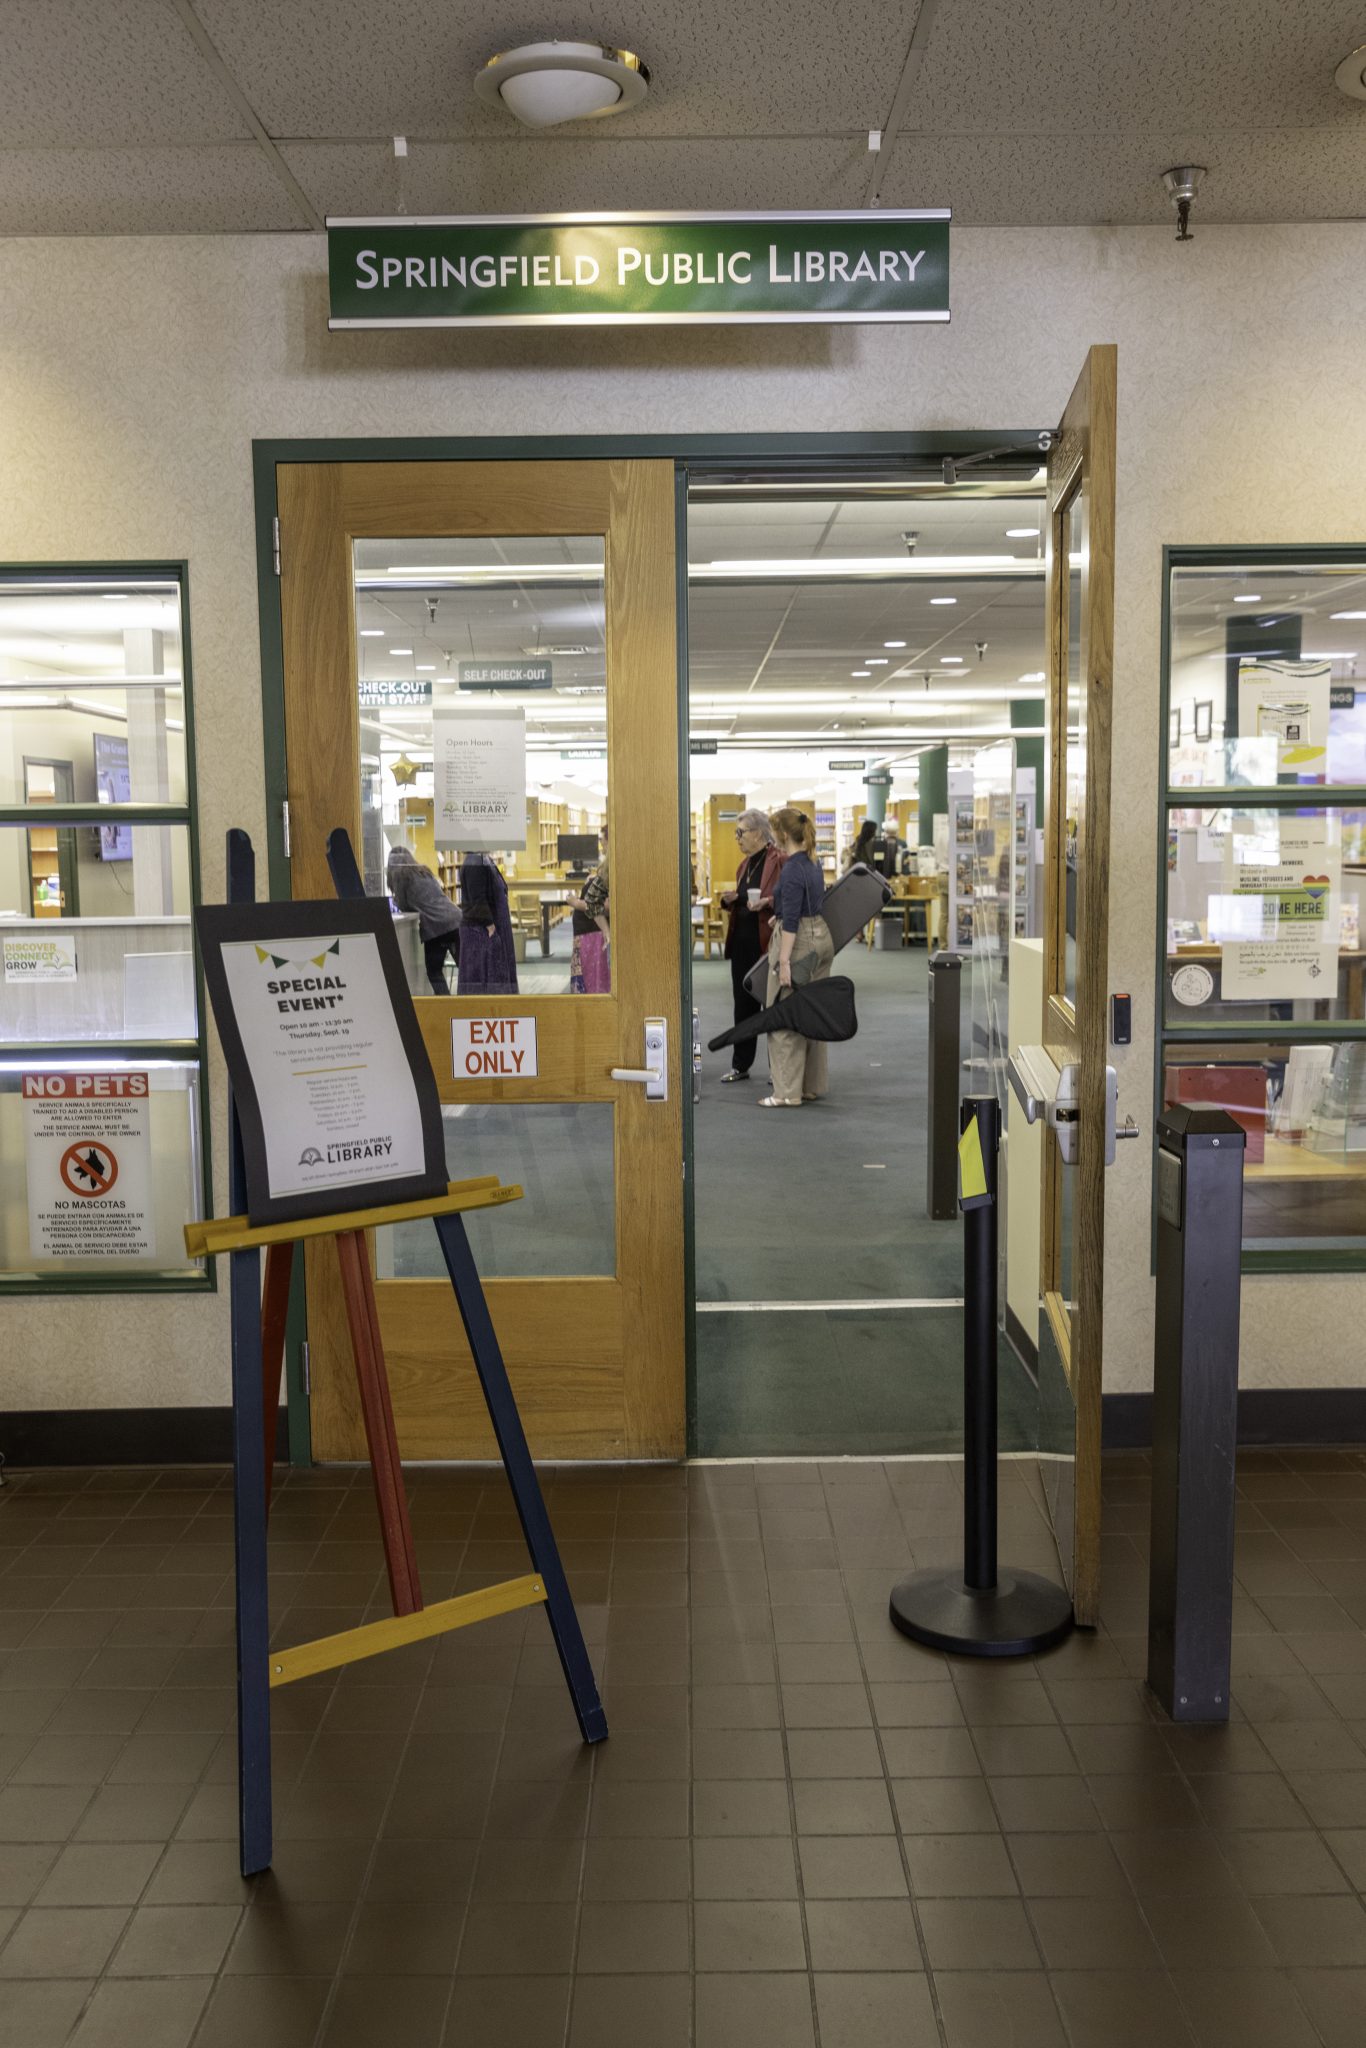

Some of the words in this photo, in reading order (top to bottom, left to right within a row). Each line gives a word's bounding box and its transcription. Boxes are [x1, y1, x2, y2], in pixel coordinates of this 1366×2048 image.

[355, 249, 600, 290] SPRINGFIELD
[617, 247, 752, 287] PUBLIC
[768, 244, 926, 283] LIBRARY
[464, 669, 489, 680] SELF
[490, 669, 547, 680] CHECK-OUT
[389, 694, 426, 704] STAFF
[446, 739, 468, 749] Open
[462, 805, 508, 813] LIBRARY
[1294, 903, 1325, 914] HERE.
[4, 943, 57, 951] DISCOVER
[5, 952, 55, 960] CONNECT
[6, 961, 37, 970] GROW
[267, 976, 346, 994] SPECIAL
[279, 1023, 298, 1031] Open
[325, 1018, 341, 1026] 11:30
[323, 1028, 340, 1037] Sept.
[470, 1020, 519, 1044] EXIT
[465, 1050, 525, 1075] ONLY
[26, 1076, 66, 1096] NO
[76, 1075, 147, 1095] PETS
[327, 1139, 368, 1150] SPRINGFIELD
[369, 1135, 392, 1144] PUBLIC
[327, 1142, 392, 1164] LIBRARY
[55, 1201, 69, 1209] NO
[72, 1201, 126, 1209] MASCOTAS
